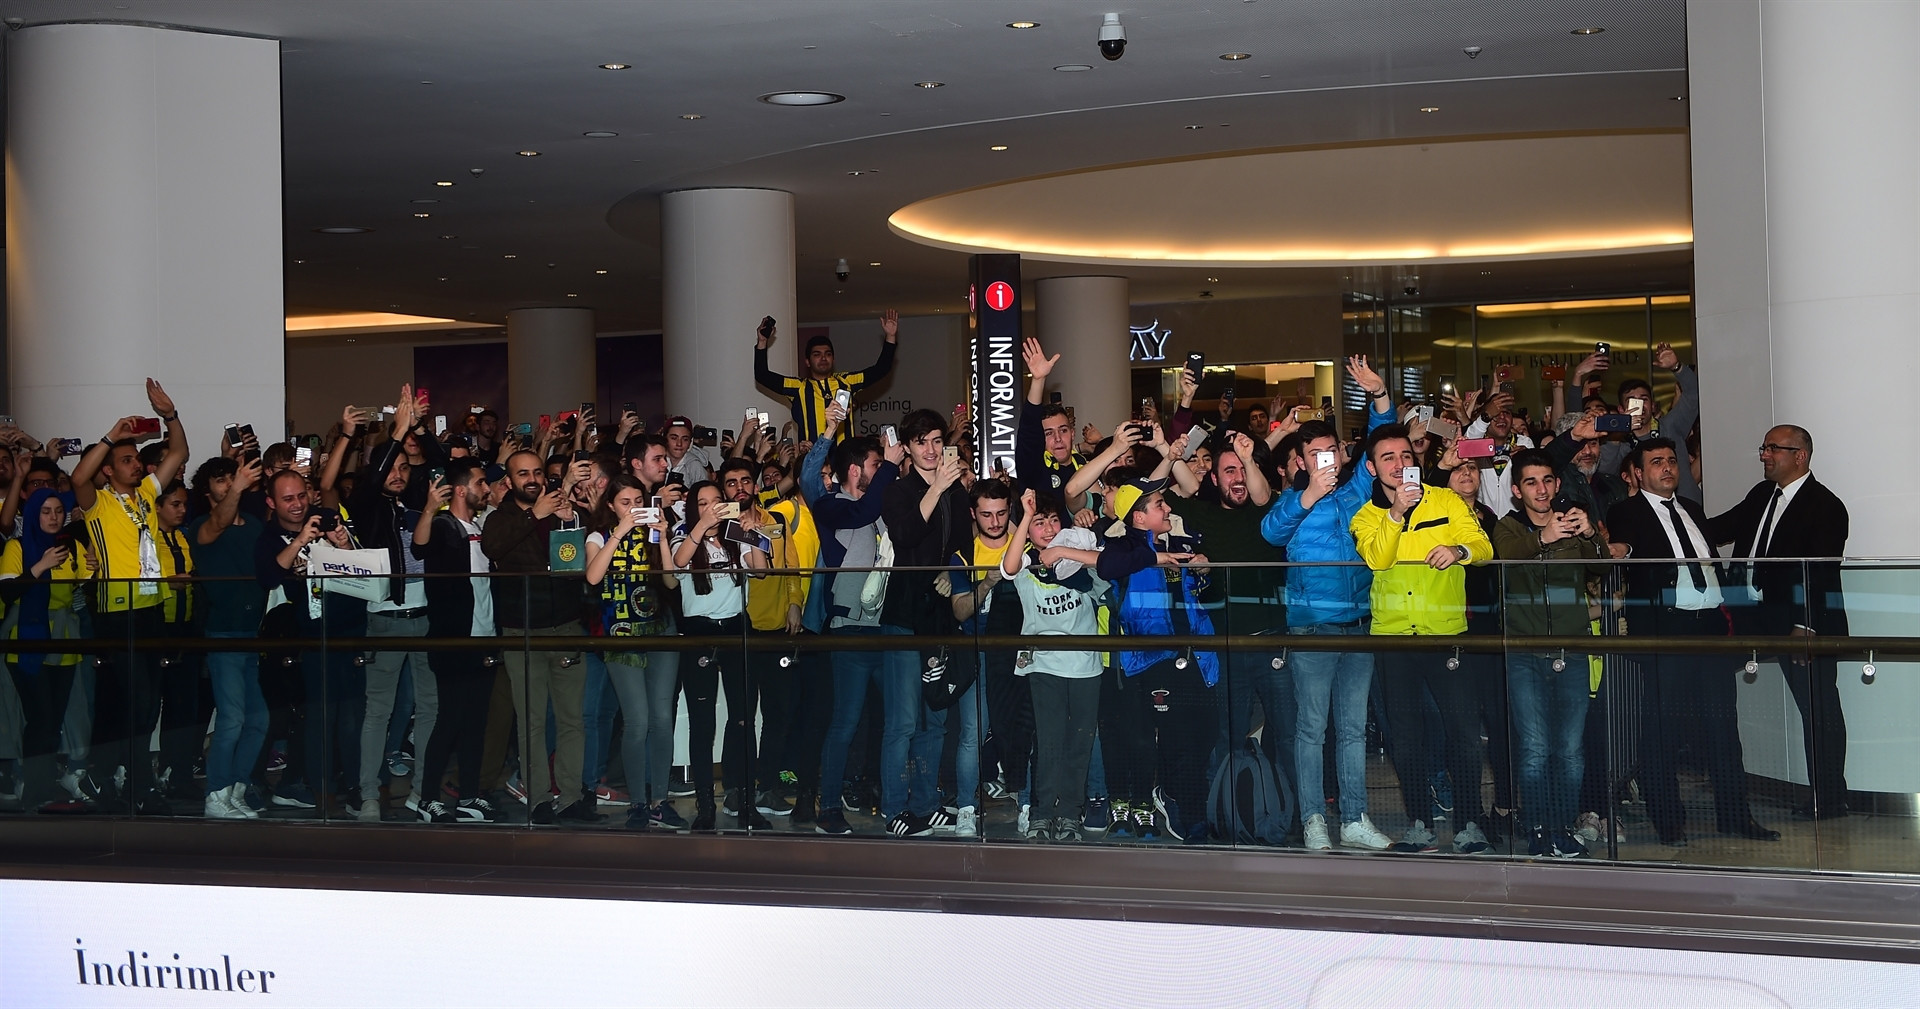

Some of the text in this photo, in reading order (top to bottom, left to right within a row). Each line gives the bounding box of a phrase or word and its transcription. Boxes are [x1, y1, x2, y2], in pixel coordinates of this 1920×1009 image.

[970, 338, 980, 481] INFORMATIO
[322, 562, 372, 575] park inn
[1036, 597, 1082, 615] TELEKOM
[73, 938, 275, 994] İndirimler
